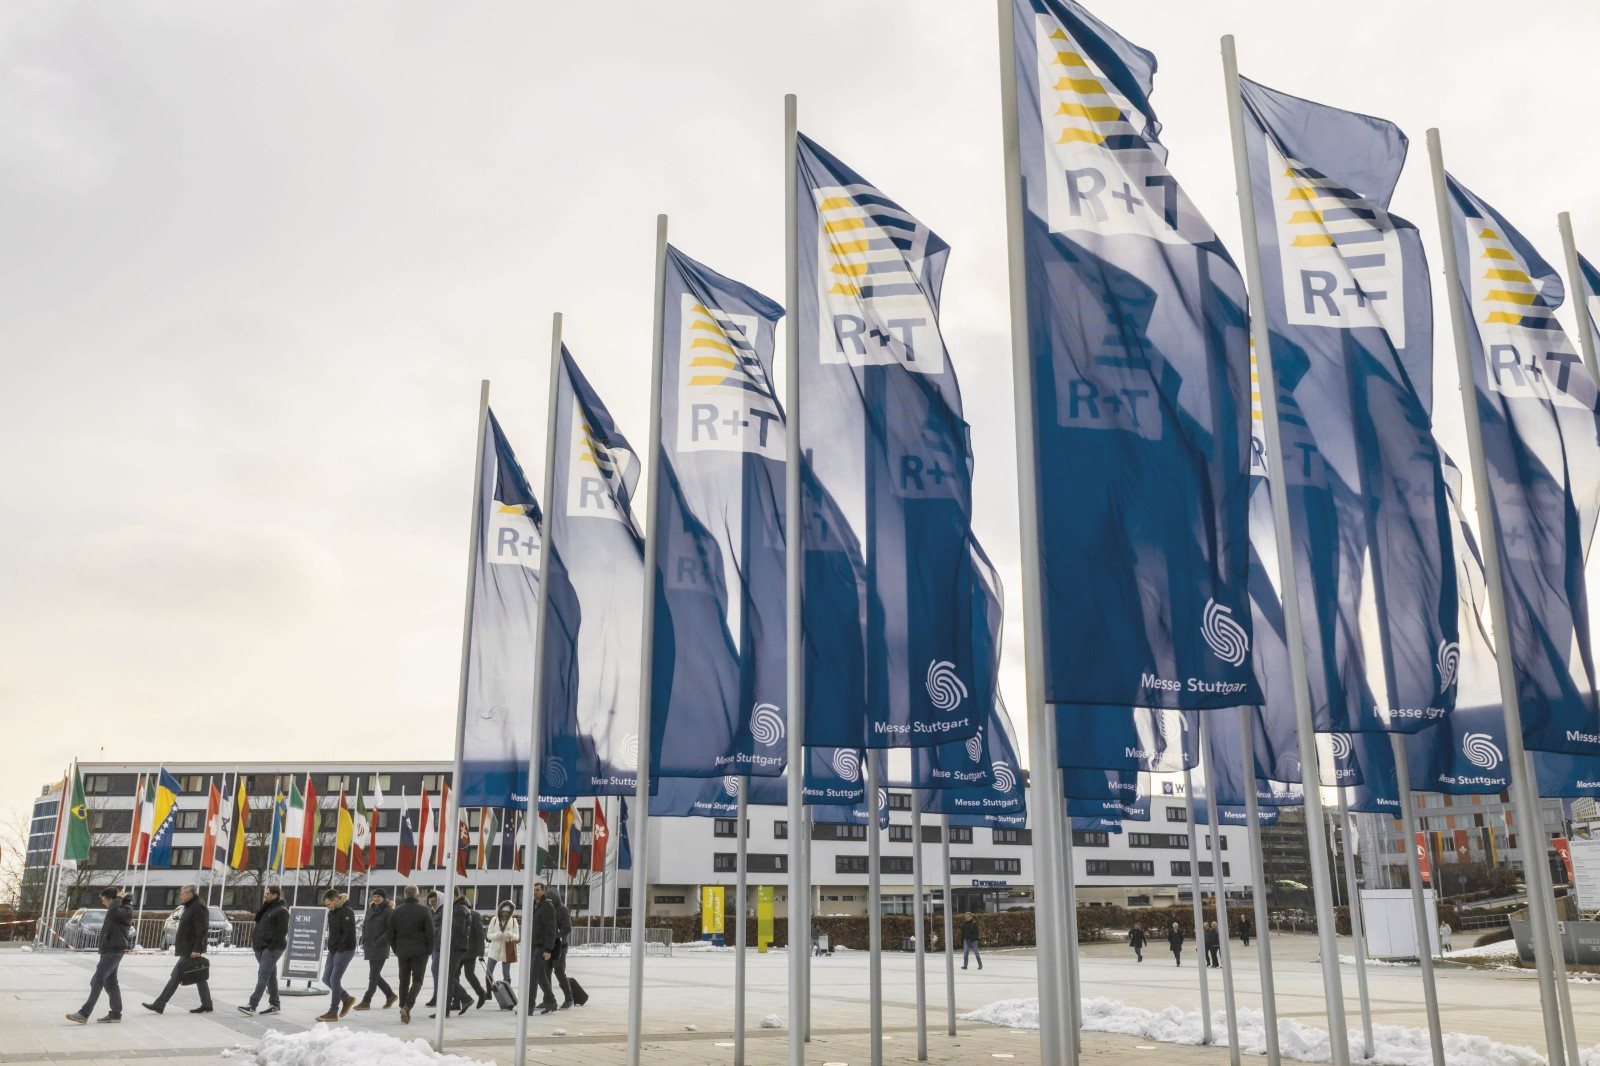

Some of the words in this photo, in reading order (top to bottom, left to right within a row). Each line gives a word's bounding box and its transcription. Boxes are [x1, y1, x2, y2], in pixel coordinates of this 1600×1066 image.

[1064, 167, 1178, 231] R+T
[834, 314, 926, 362] R+T
[1490, 344, 1583, 396] R+T
[1068, 378, 1150, 428] R+T
[690, 403, 780, 448] R+T
[900, 455, 953, 490] R+
[496, 526, 540, 558] R+
[1141, 673, 1182, 691] Messe
[1187, 678, 1247, 695] Stuttgar
[874, 721, 911, 734] Messe
[913, 717, 969, 734] Stuttgart
[1566, 730, 1598, 743] Messe
[715, 756, 735, 766] Messe
[736, 752, 782, 766] Stuttgart
[610, 777, 637, 787] Stuttg
[954, 771, 987, 782] Stuttgart
[1458, 776, 1506, 786] Stuttgart
[1109, 781, 1134, 790] Messe
[538, 795, 568, 805] tuttgart
[713, 802, 737, 811] Stuttgar
[983, 799, 1018, 808] Stuttgart
[997, 816, 1025, 824] Stuttgart
